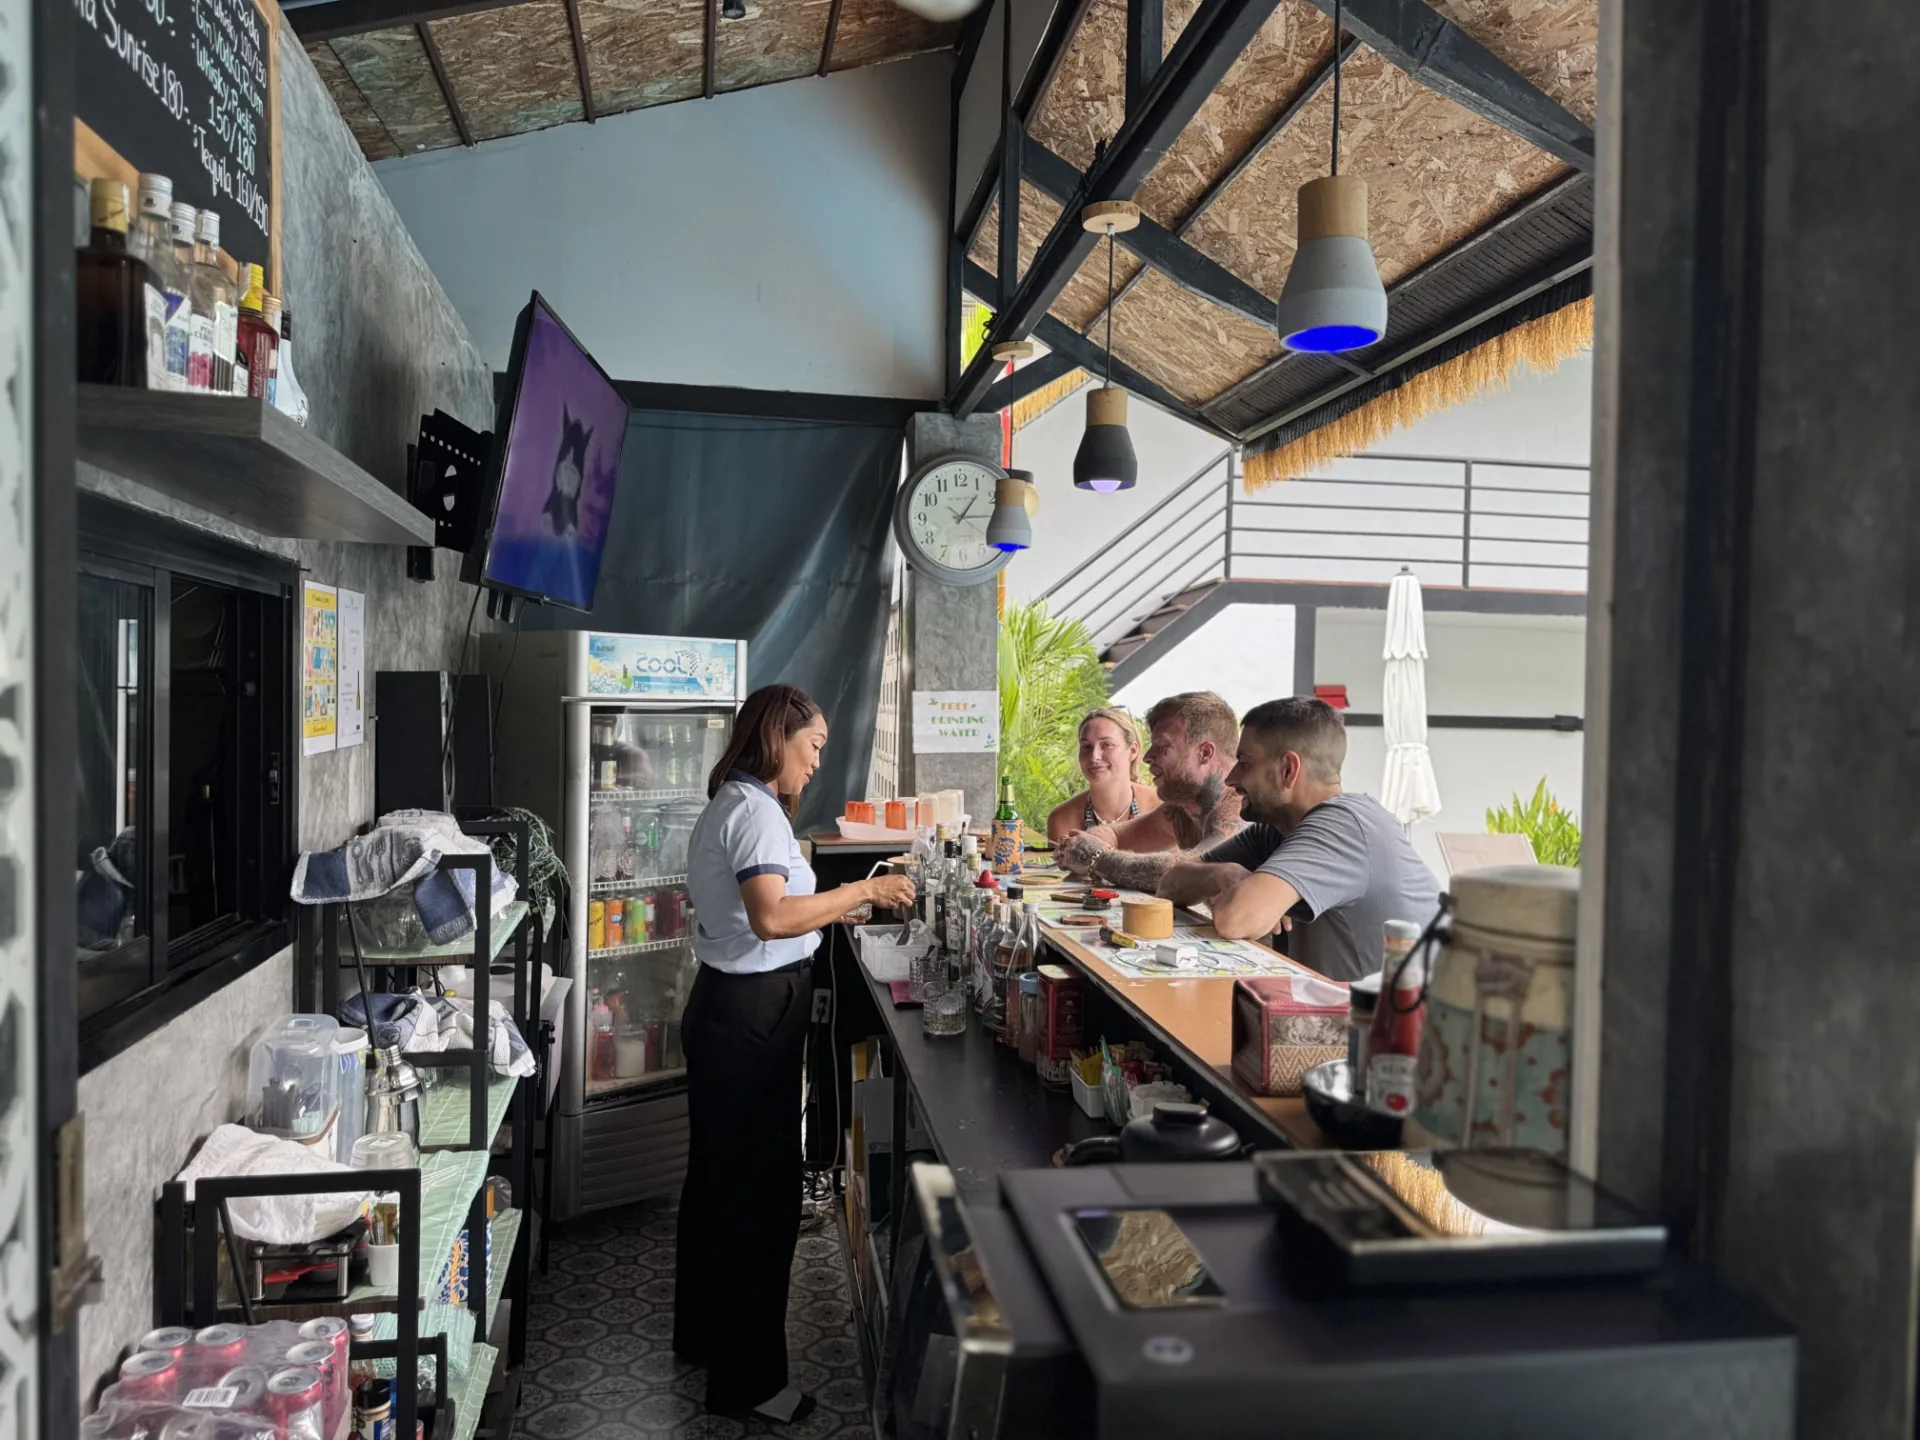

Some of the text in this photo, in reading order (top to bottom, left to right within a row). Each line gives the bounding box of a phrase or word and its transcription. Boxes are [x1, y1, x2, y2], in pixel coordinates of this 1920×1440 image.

[936, 479, 948, 493] 11
[954, 473, 968, 487] 12
[974, 477, 980, 491] 1
[924, 493, 938, 507] 10
[918, 512, 927, 526] 9
[925, 531, 935, 545] 8
